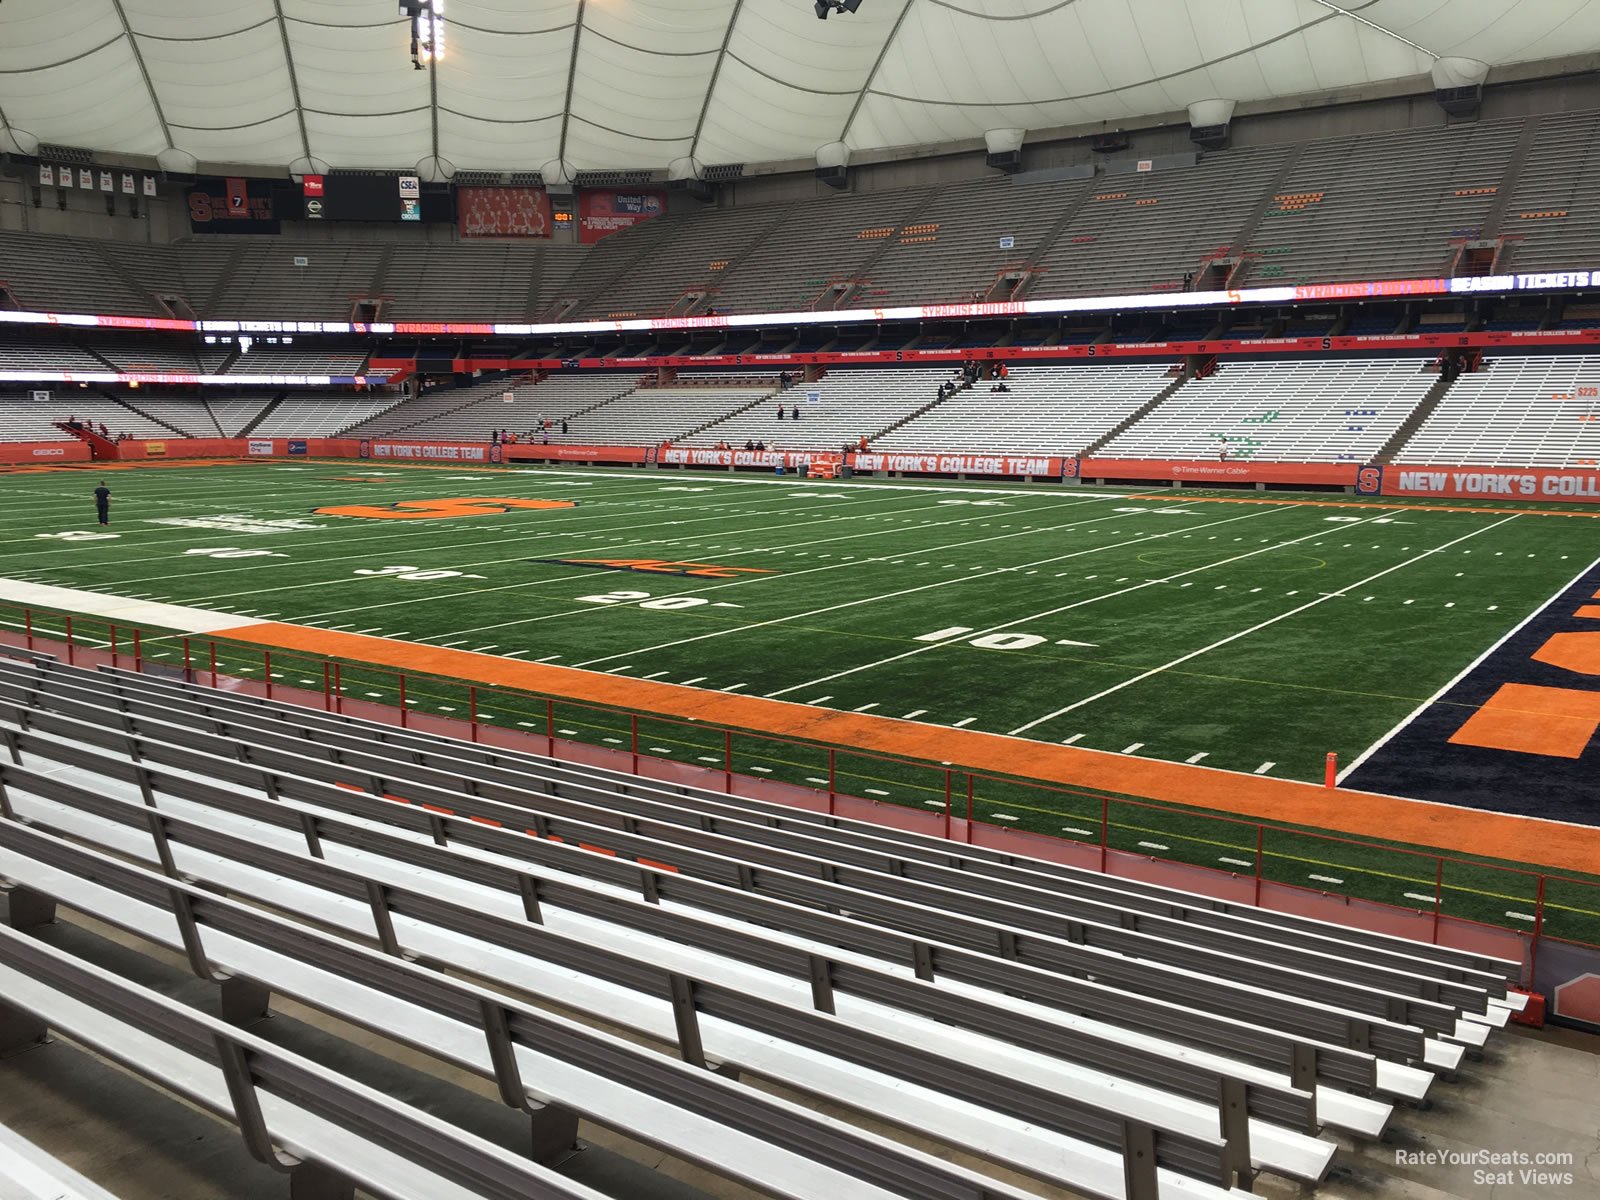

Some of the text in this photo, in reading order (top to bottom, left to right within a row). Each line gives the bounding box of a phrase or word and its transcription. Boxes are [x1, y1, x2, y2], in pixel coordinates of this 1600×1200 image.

[233, 197, 241, 207] 7
[617, 195, 641, 203] United
[627, 203, 641, 213] Way
[1451, 275, 1514, 292] SEASON
[1517, 272, 1589, 289] TICKETS
[1296, 283, 1368, 300] SYRACUSE
[922, 302, 1026, 318] SYRACUSE FOOTBALL
[396, 323, 445, 333] SYRACUSE
[651, 316, 728, 329] SYRACUSE FOOTBALL
[1577, 387, 1598, 397] $225
[33, 448, 64, 456] GEICO
[374, 444, 484, 460] NEW YORK'S COLLEGE TEAM
[665, 449, 811, 467] NEW YORK'S COLLEGE TEA
[855, 454, 1050, 475] NEW YORK'S COLLEGE TEAM
[1199, 466, 1225, 474] Warner
[1226, 466, 1248, 475] Cable
[1359, 467, 1380, 493] S
[1399, 472, 1447, 491] NEW
[1452, 473, 1537, 495] YORK'S
[353, 565, 463, 580] 30
[574, 591, 709, 610] 20
[912, 626, 1048, 650] 10
